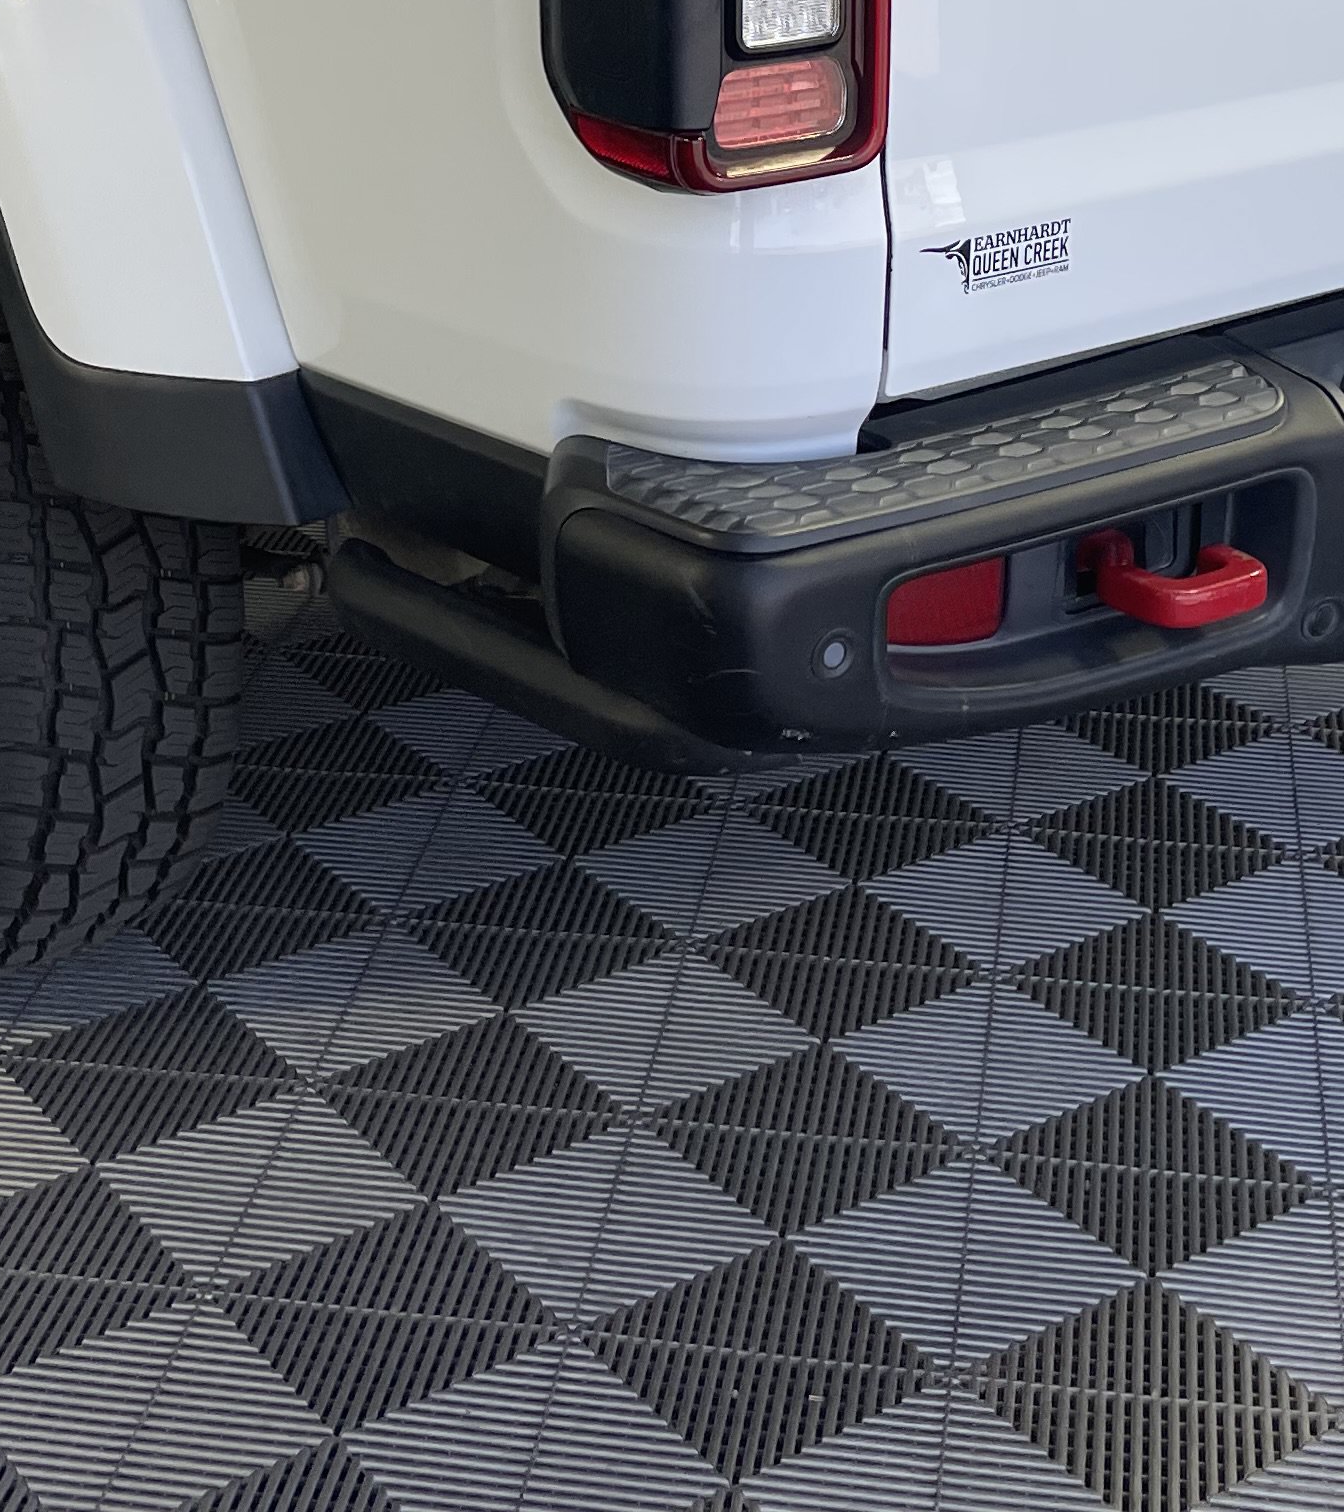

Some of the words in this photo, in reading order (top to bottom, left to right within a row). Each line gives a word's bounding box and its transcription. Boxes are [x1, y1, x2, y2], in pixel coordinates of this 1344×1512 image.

[974, 218, 1071, 252] EARNHARDT
[973, 247, 1019, 276] QUEEN
[1025, 236, 1069, 265] CREEK
